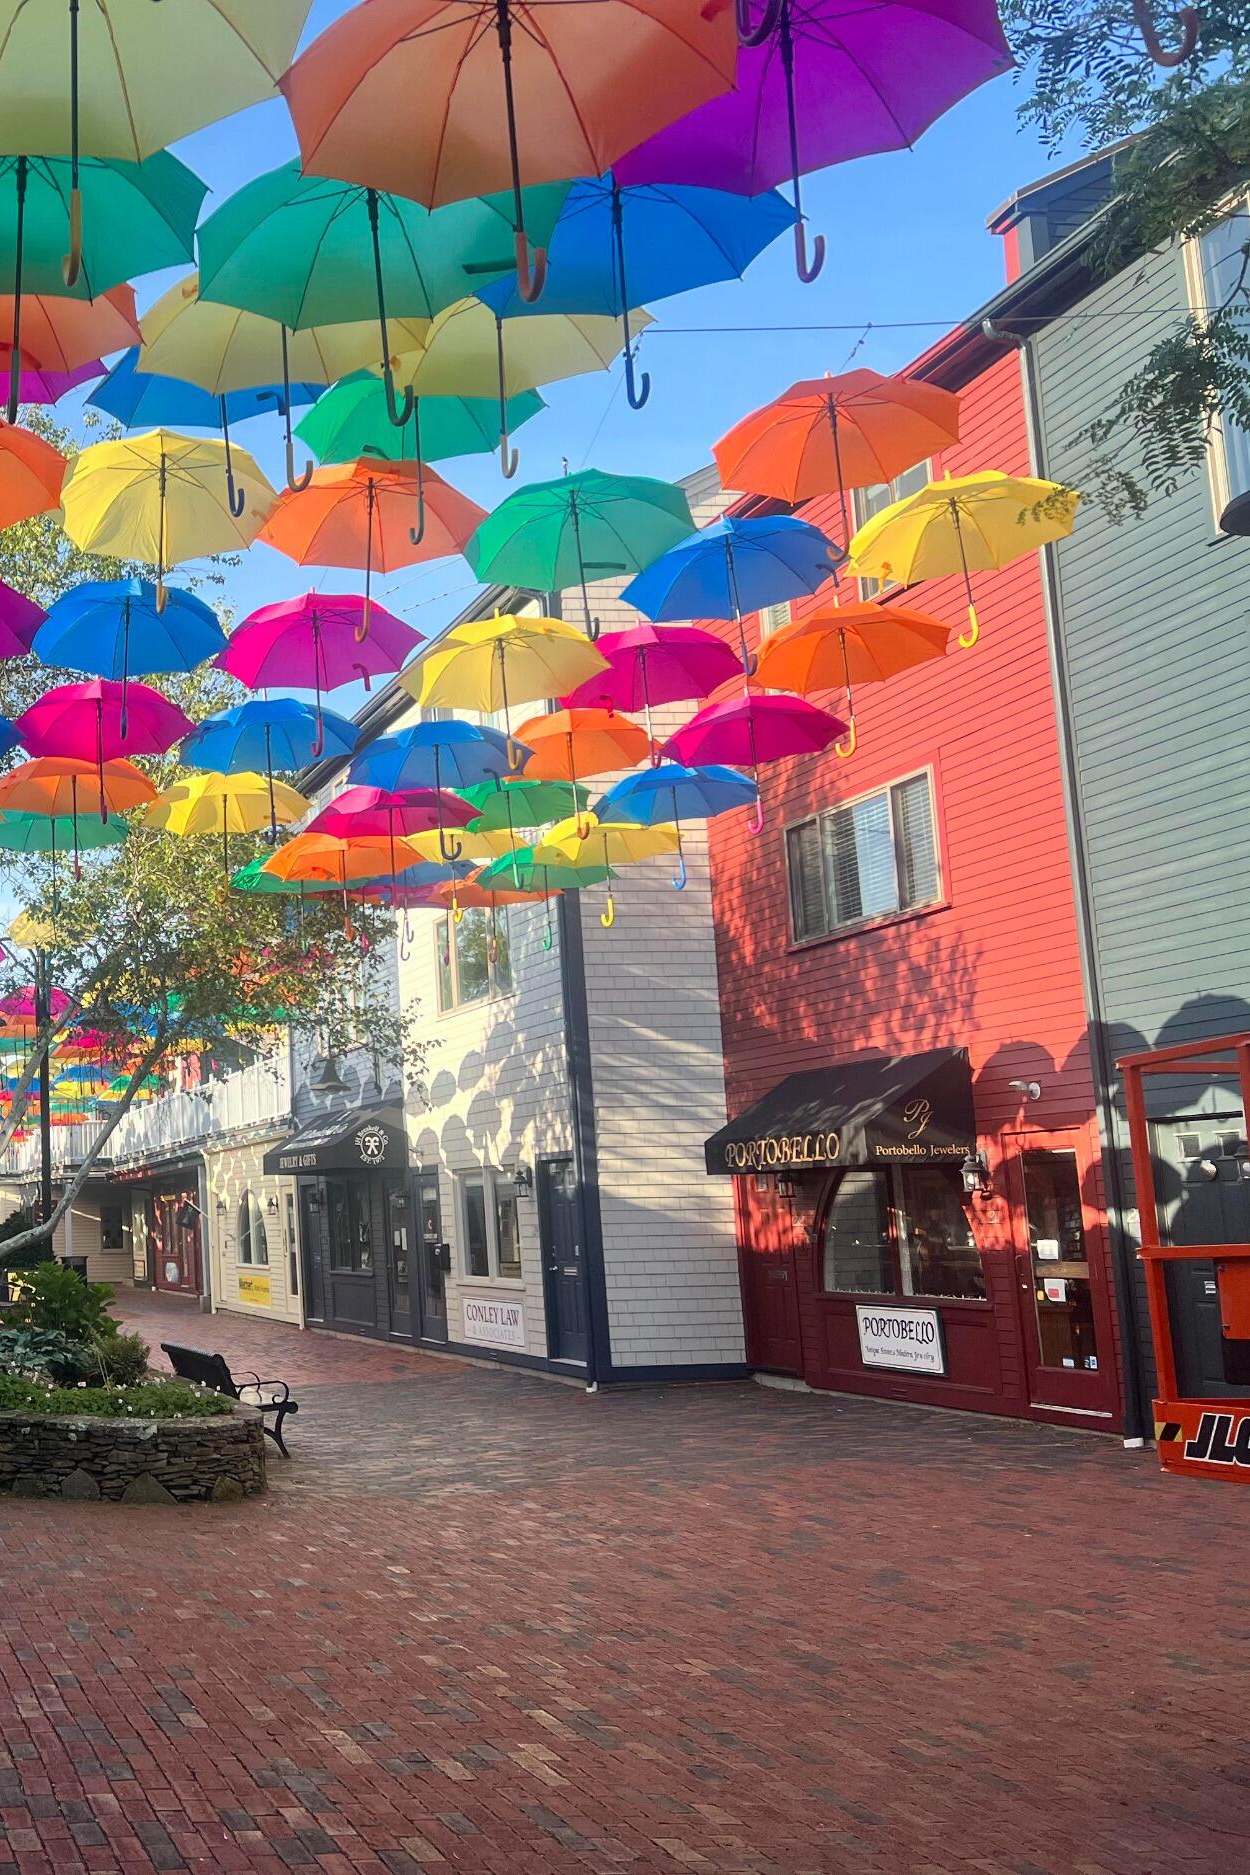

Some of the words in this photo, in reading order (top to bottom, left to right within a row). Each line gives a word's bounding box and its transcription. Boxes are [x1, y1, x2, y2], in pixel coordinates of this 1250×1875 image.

[279, 1156, 298, 1169] JEWELRY
[299, 1155, 303, 1167] &
[303, 1153, 317, 1167] GIFTS
[725, 1132, 840, 1169] PORTOBELLO
[876, 1144, 927, 1156] Portobello
[930, 1144, 970, 1156] Jewelers
[466, 1304, 499, 1324] CONLEY
[500, 1308, 520, 1326] LAW
[863, 1317, 935, 1344] PORTOBELLO
